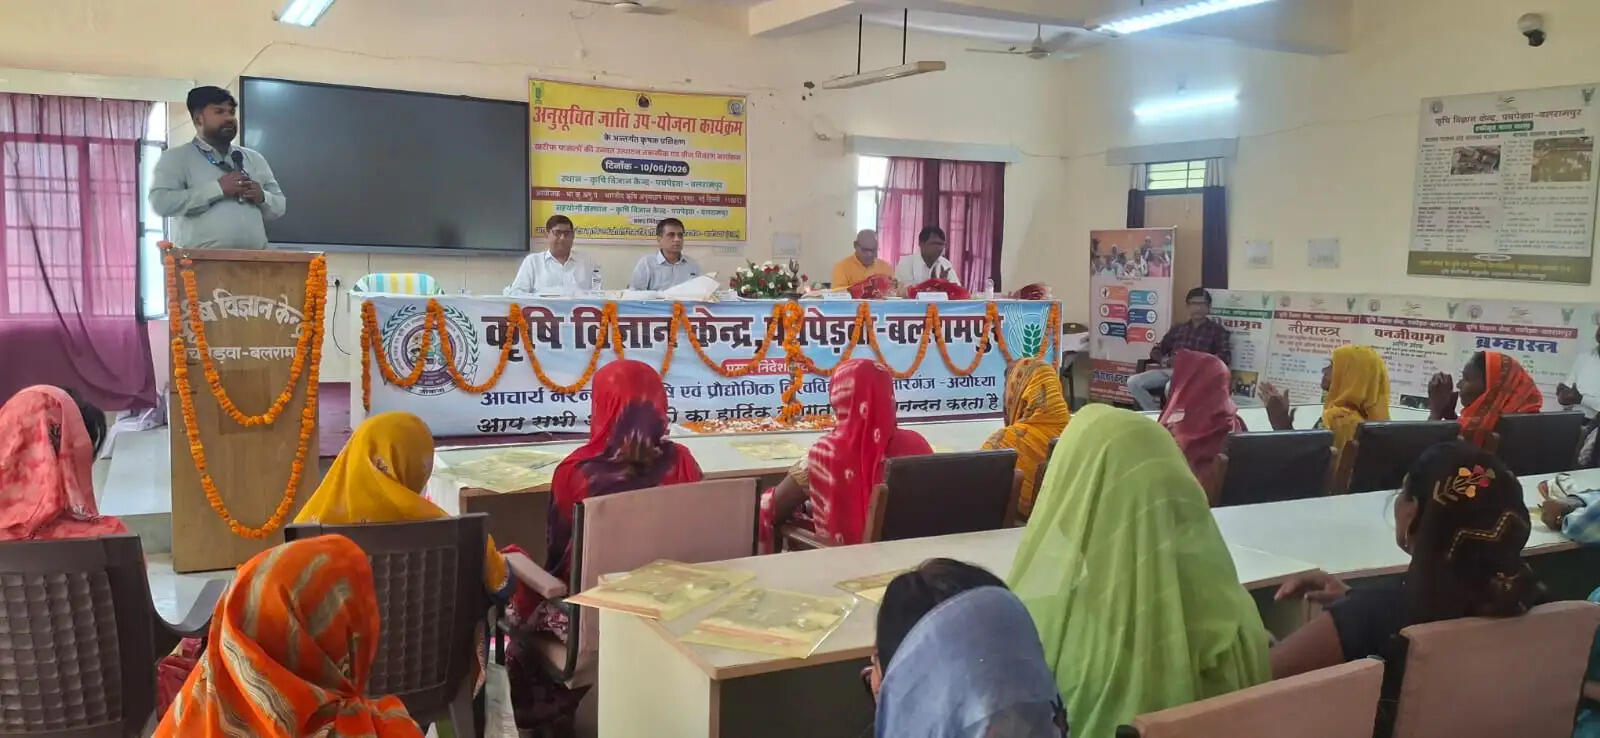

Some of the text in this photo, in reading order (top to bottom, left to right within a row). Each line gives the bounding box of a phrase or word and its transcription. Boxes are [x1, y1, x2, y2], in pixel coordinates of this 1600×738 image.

[533, 104, 594, 131] अनुसूचित
[598, 107, 630, 128] जाति
[699, 115, 743, 136] कार्यक्रम
[603, 132, 686, 146] के अन्तर्गत कृषक प्रशिक्षण
[590, 175, 606, 185] कृषि
[608, 176, 632, 185] विज्ञान
[213, 288, 274, 321] विज्ञान
[481, 306, 565, 362] कृषि
[570, 306, 679, 349] विज्ञान
[1288, 321, 1341, 337] नीमास्त्र
[481, 387, 545, 405] आचार्य
[680, 381, 702, 398] एवं
[707, 380, 775, 399] प्रौद्योगिक
[947, 374, 996, 389] अयोध्या
[477, 417, 526, 433] आप
[532, 410, 577, 428] सभी
[685, 409, 711, 422] का
[716, 403, 773, 421] हार्दिक
[946, 397, 985, 410] करता
[986, 392, 999, 410] है
